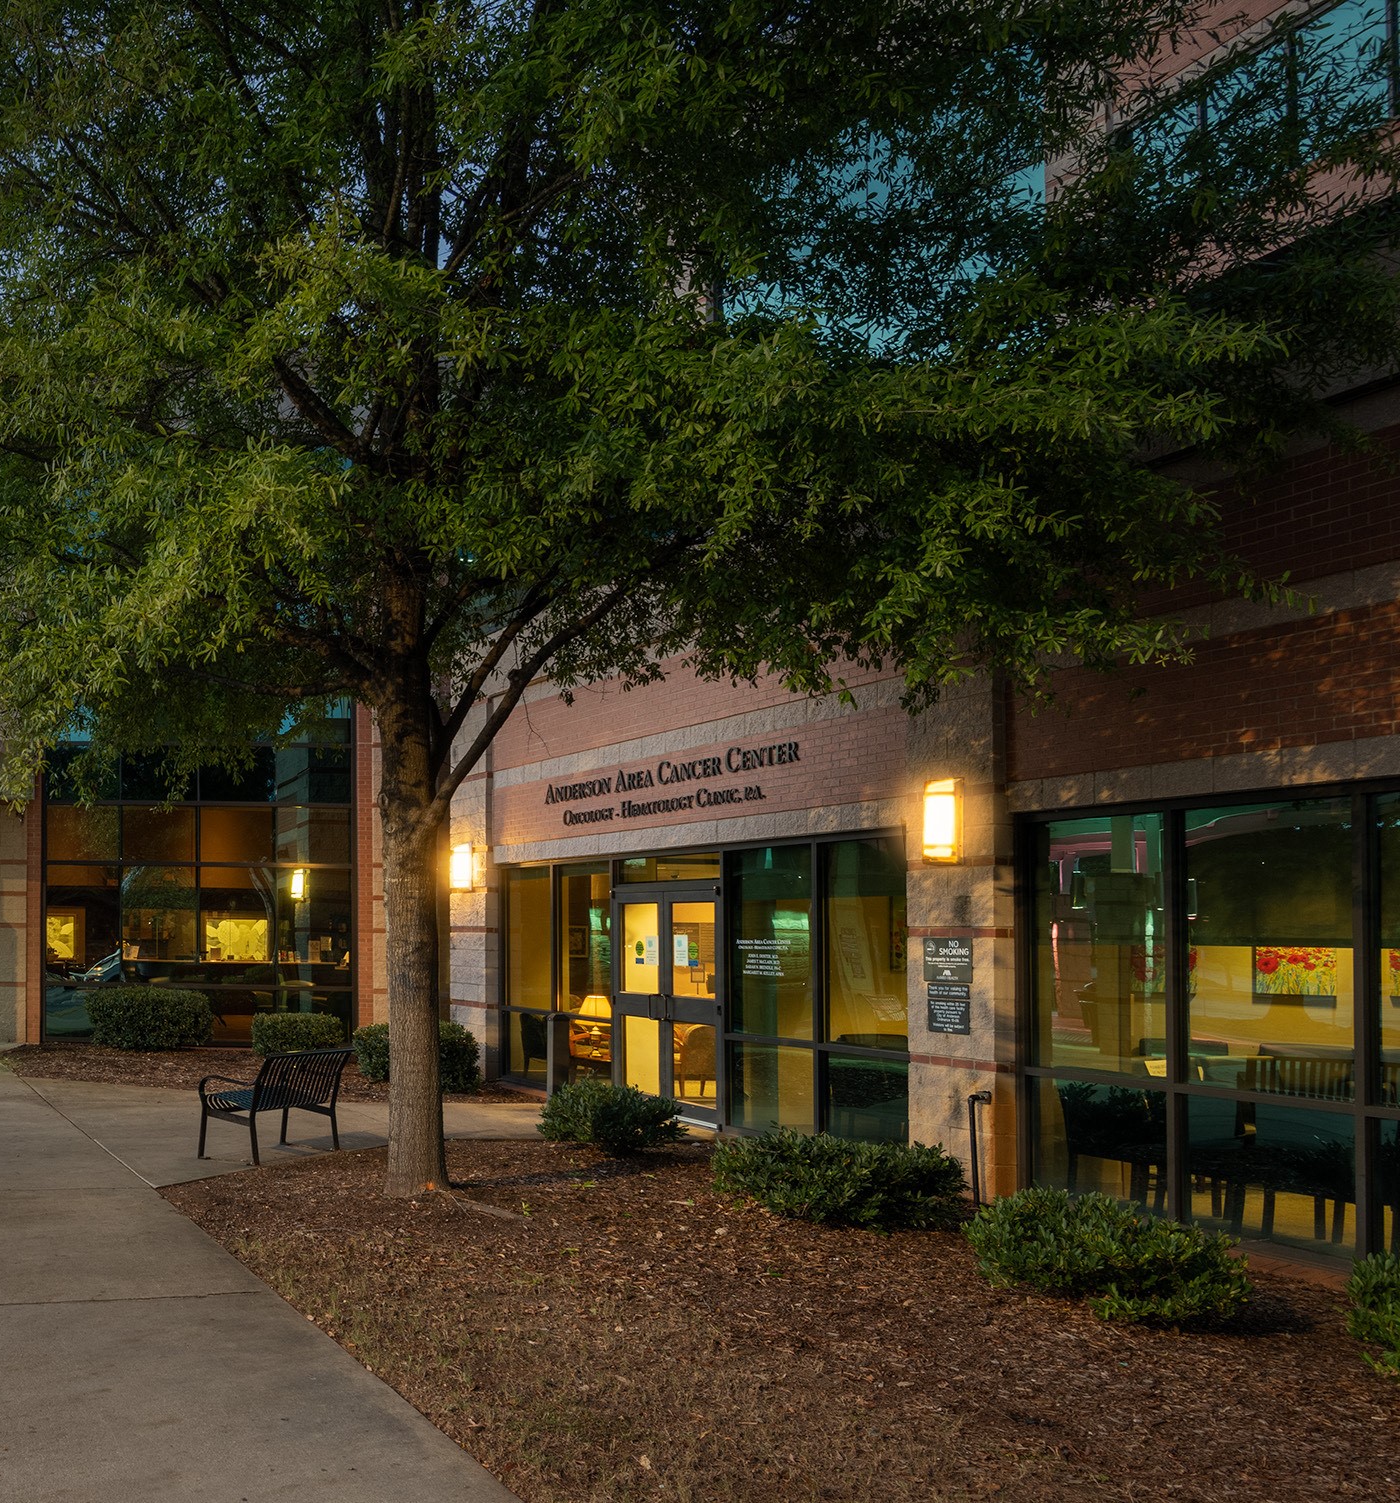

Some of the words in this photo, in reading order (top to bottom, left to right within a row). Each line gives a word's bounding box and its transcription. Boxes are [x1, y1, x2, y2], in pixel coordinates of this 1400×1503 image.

[544, 777, 612, 805] ANDERSON
[614, 769, 655, 793] AREA
[657, 756, 722, 785] CANCER
[725, 741, 800, 773] CENTER
[563, 807, 615, 826] ONCOLOGY
[620, 795, 695, 819] HEMATOLOGY
[938, 947, 969, 956] SMOKING
[948, 940, 959, 948] NO
